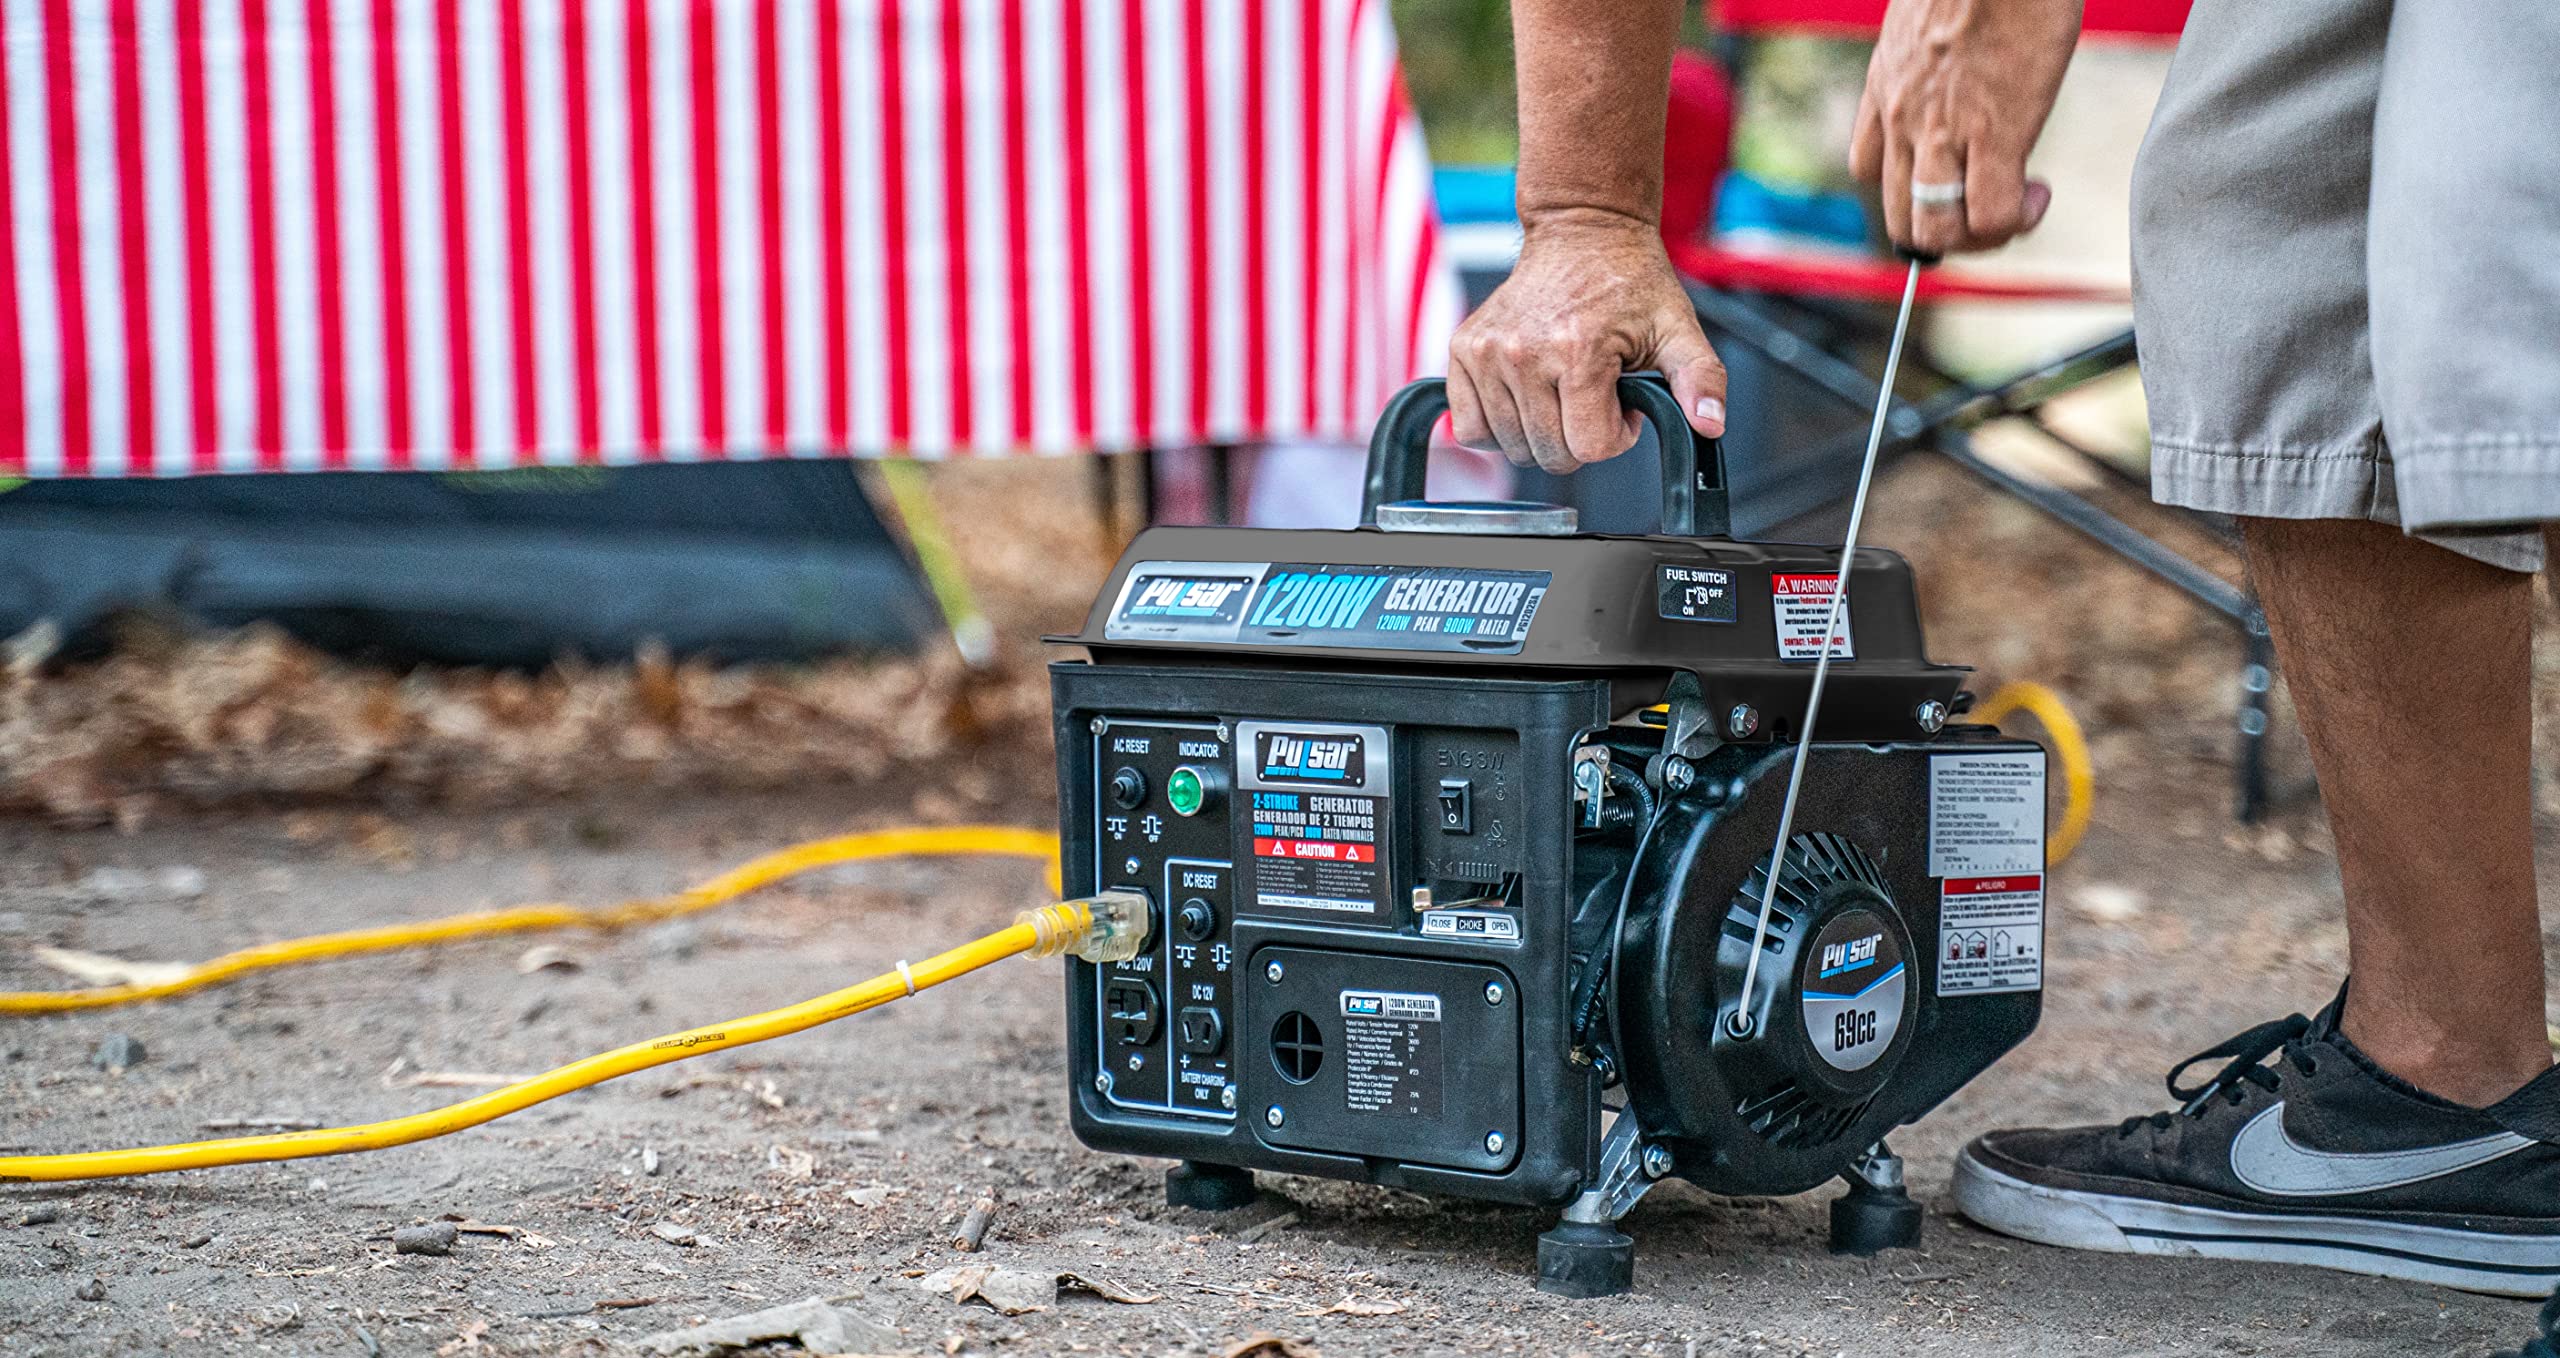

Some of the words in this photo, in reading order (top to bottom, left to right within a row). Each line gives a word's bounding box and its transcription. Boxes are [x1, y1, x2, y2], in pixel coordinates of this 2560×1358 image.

[1666, 568, 1690, 582] FUEL
[1692, 570, 1728, 585] SWITCH
[1135, 577, 1243, 616] Pulsar
[1249, 571, 1389, 629] 1200W
[1383, 577, 1527, 615] GENERATOR
[1709, 588, 1723, 598] OFF
[1682, 606, 1694, 616] ON
[1375, 613, 1411, 631] 1200W
[1413, 615, 1440, 633] PEAK
[1442, 616, 1475, 634] 900W
[1476, 618, 1511, 636] RATED
[1113, 738, 1125, 752] AC
[1126, 739, 1150, 754] RESET
[1179, 742, 1219, 758] INDICATOR
[1266, 735, 1358, 779] Pulsar
[1253, 793, 1299, 811] 2-STROKE
[1310, 796, 1374, 815] GENERATOR
[1253, 810, 1306, 826] GENERADOR
[1309, 813, 1321, 827] DE
[1323, 814, 1330, 827] 2
[1333, 815, 1374, 829] TIEMPOS
[1148, 834, 1159, 843] OFF
[1295, 843, 1336, 858] CAUTION
[1183, 872, 1194, 888] DC
[1194, 874, 1218, 890] RESET
[1981, 880, 2006, 890] PELIGRO
[1430, 913, 1452, 929] CLOSE
[1458, 918, 1483, 931] CHOKE
[1491, 920, 1509, 932] OPEN
[1821, 933, 1882, 974] Pulsar
[1132, 957, 1152, 972] 120V
[1216, 963, 1227, 972] OFF
[1192, 984, 1201, 1000] DC
[1203, 985, 1214, 1001] 12V
[1181, 1071, 1201, 1085] BATTERY
[1202, 1074, 1225, 1087] CHARGING
[1194, 1088, 1209, 1099] ONLY
